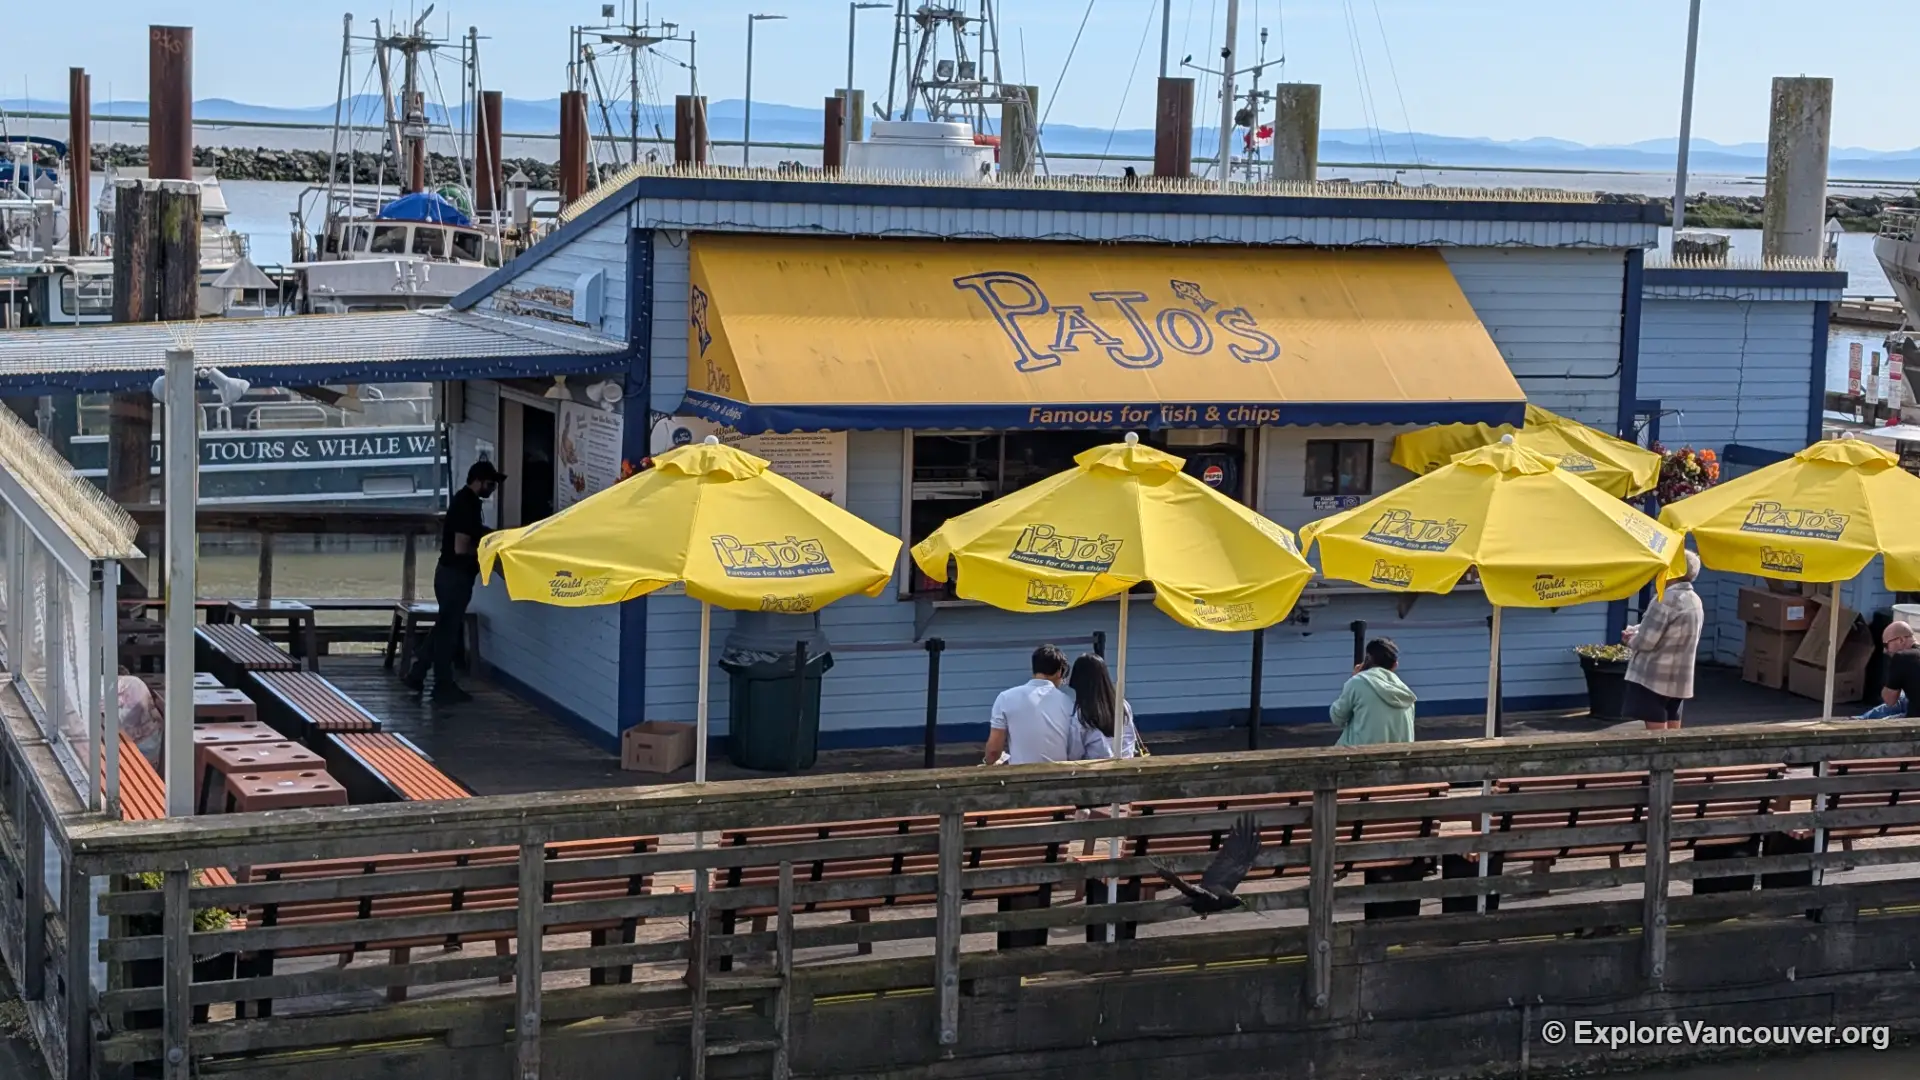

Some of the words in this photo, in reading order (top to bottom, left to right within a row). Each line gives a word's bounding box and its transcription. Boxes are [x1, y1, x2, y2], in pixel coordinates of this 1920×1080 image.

[1028, 407, 1113, 424] Famous
[1120, 405, 1152, 422] for
[1160, 404, 1197, 422] fish
[1205, 405, 1221, 421] &
[1227, 404, 1281, 425] chips
[206, 442, 285, 460] TOURS
[291, 440, 311, 458] &
[317, 437, 401, 457] WHALE
[407, 435, 437, 453] WA
[1011, 552, 1044, 564] Famous
[1045, 559, 1060, 567] for
[1060, 562, 1076, 570] fish
[726, 569, 762, 577] Famous
[762, 569, 777, 577] for
[778, 568, 796, 577] fish
[807, 566, 832, 575] chips
[548, 577, 583, 589] World
[1533, 578, 1566, 592] World
[551, 587, 588, 598] Famous
[1538, 587, 1578, 601] Famous
